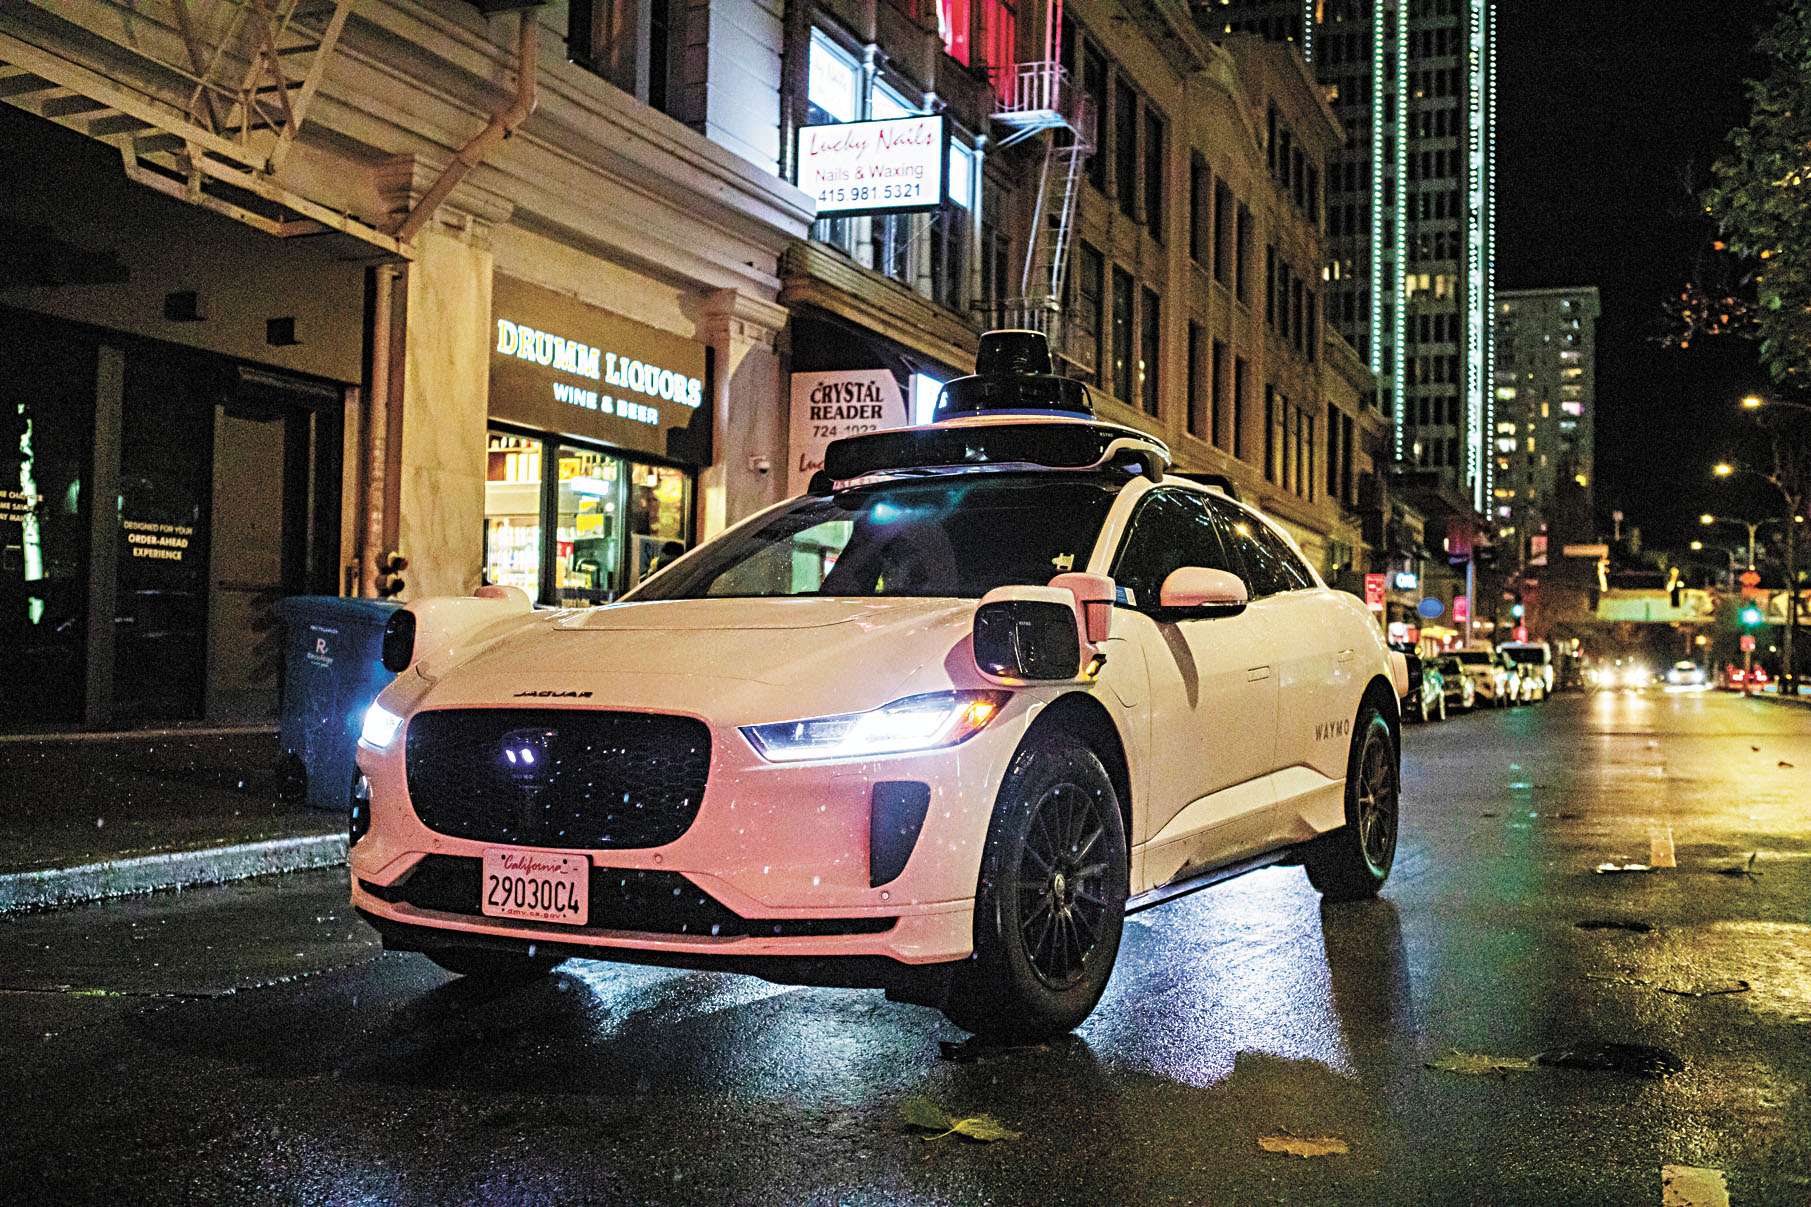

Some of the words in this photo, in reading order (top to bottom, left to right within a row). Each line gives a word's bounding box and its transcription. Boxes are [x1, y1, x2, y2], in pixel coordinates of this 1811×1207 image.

[810, 129, 869, 160] Lucky
[876, 123, 935, 154] Nails
[815, 167, 849, 183] Nails
[855, 166, 865, 180] &
[870, 163, 925, 180] Waxing
[818, 183, 921, 202] 415.981.5321
[497, 319, 601, 380] DRUMM
[605, 352, 702, 408] LIQUORS
[810, 381, 884, 404] CRYSTAL
[553, 382, 598, 410] WINE
[600, 395, 614, 414] &
[616, 399, 658, 425] BEER
[810, 405, 882, 420] READER
[124, 520, 159, 532] DESIGNED
[160, 524, 174, 534] FOR
[175, 526, 193, 535] YOUR
[128, 533, 189, 548] ORDER-AHEAD
[133, 546, 182, 560] EXPERIENCE
[513, 690, 593, 698] JAGUAR
[1315, 718, 1350, 741] WAYMO
[504, 854, 563, 875] California
[488, 874, 579, 914] 29030C4
[507, 908, 561, 919] dmv.ca.gov
